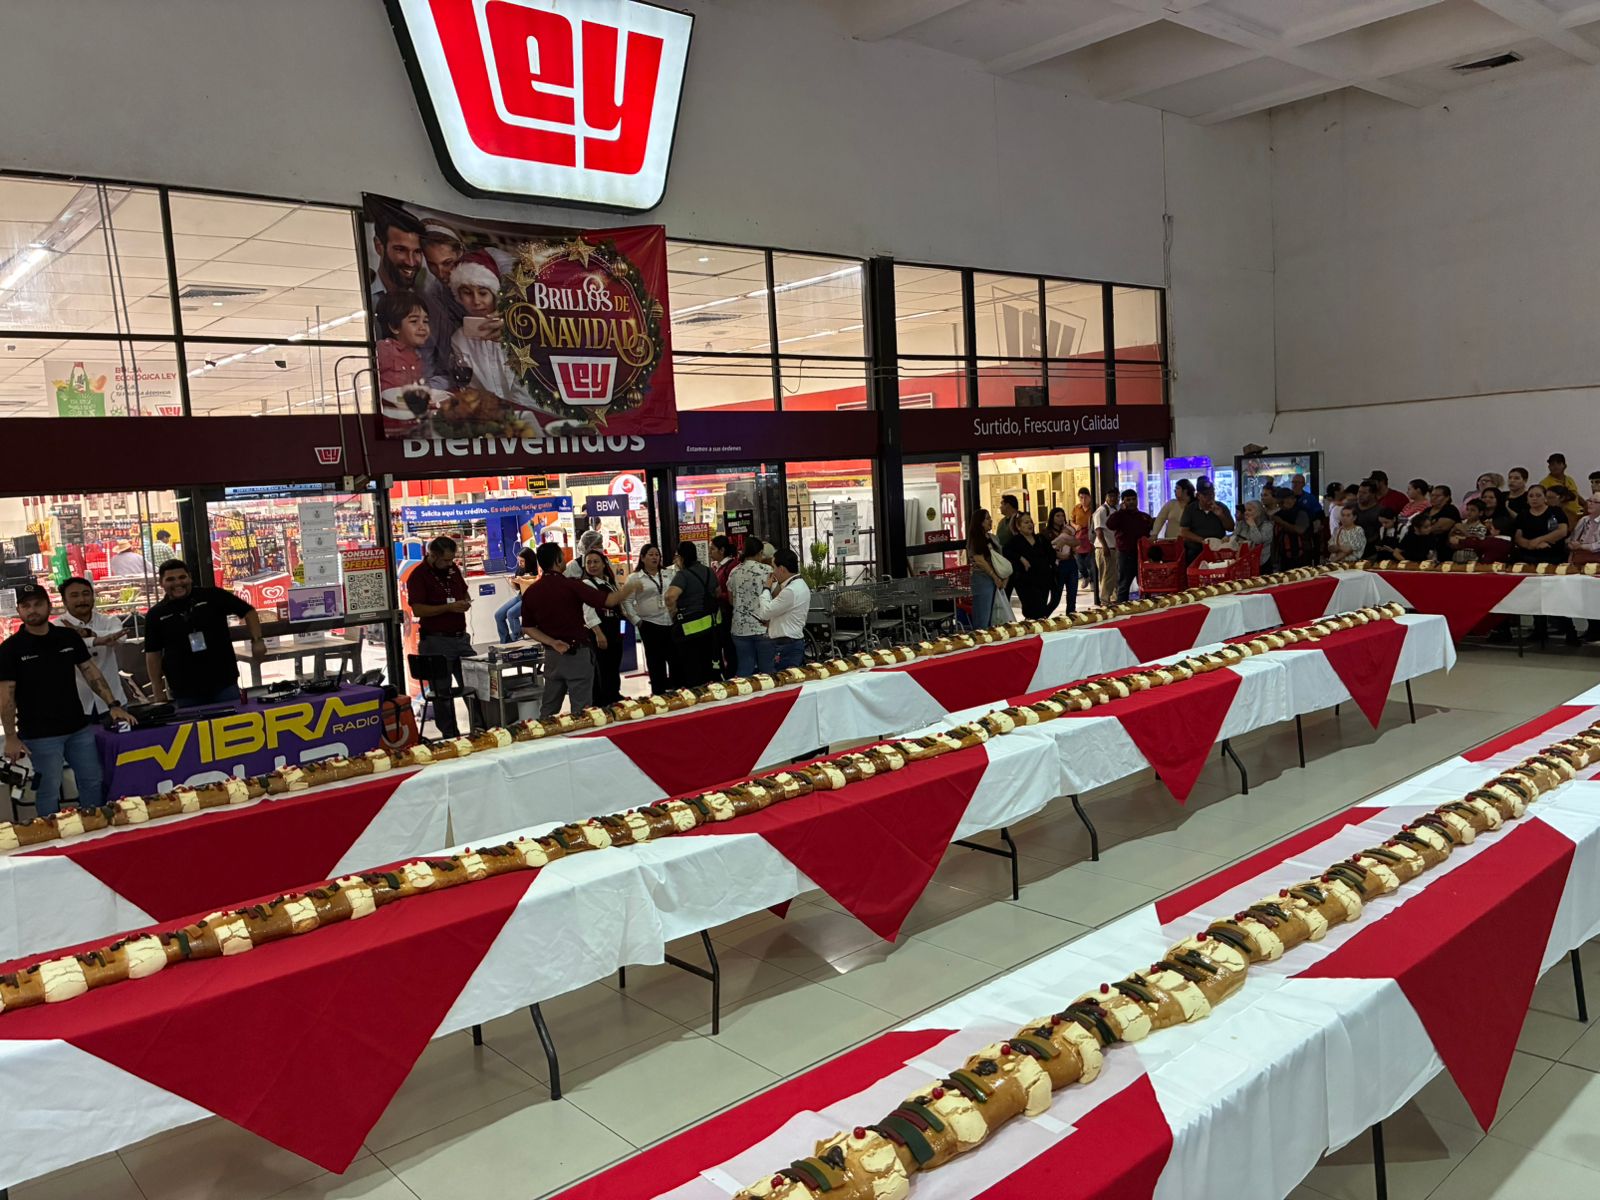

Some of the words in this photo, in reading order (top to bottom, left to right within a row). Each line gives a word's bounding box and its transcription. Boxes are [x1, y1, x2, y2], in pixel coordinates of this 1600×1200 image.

[534, 275, 613, 312] BRILLOS
[614, 295, 631, 313] DE
[161, 372, 177, 380] LEY
[973, 417, 1022, 436] Surtido,
[1024, 417, 1071, 433] Frescura
[1072, 419, 1079, 435] y
[1081, 414, 1120, 431] Calidad
[596, 499, 620, 512] BBVA
[442, 508, 455, 517] aquí
[680, 523, 708, 532] CONSULTA
[680, 532, 708, 541] OFERTAS
[342, 548, 385, 558] CONSULTA
[343, 558, 385, 569] OFERTAS
[332, 715, 380, 734] RADIO
[116, 696, 380, 771] VIBRA
